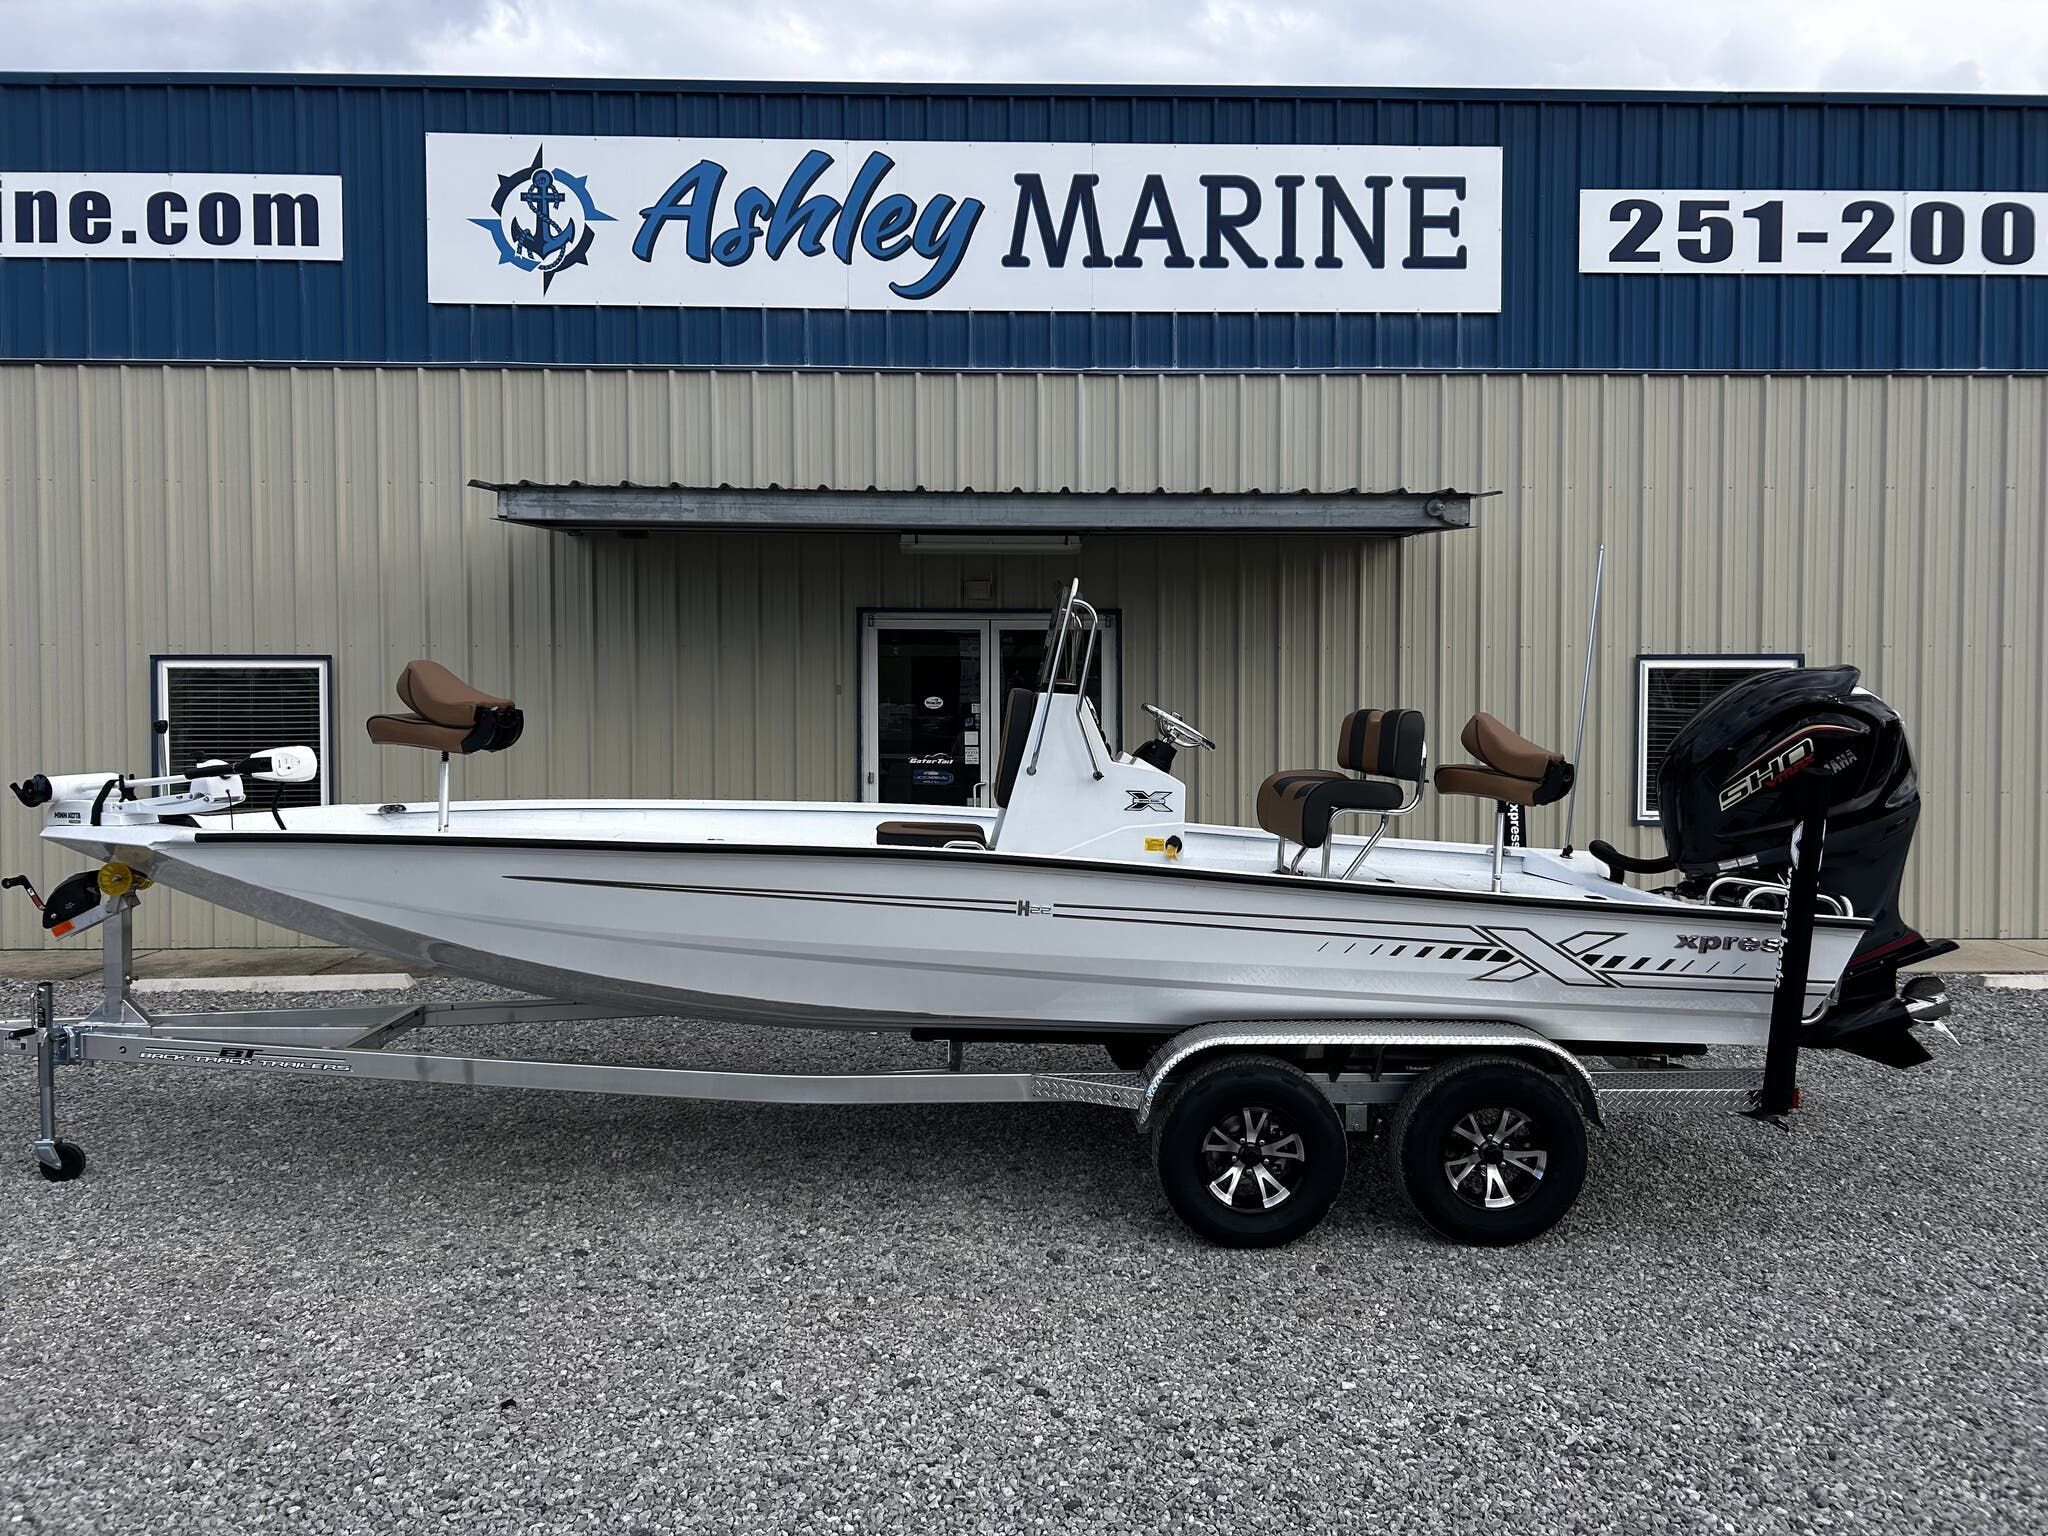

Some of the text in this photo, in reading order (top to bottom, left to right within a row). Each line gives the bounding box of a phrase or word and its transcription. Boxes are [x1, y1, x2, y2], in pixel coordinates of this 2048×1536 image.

[0, 180, 319, 247] ne.com
[632, 149, 1468, 300] Ashley MARINE
[1608, 199, 2036, 265] 251-200
[1719, 737, 1814, 812] SHO
[1674, 934, 1781, 954] xpres
[139, 1051, 352, 1072] BACK TRACK TRAILERS
